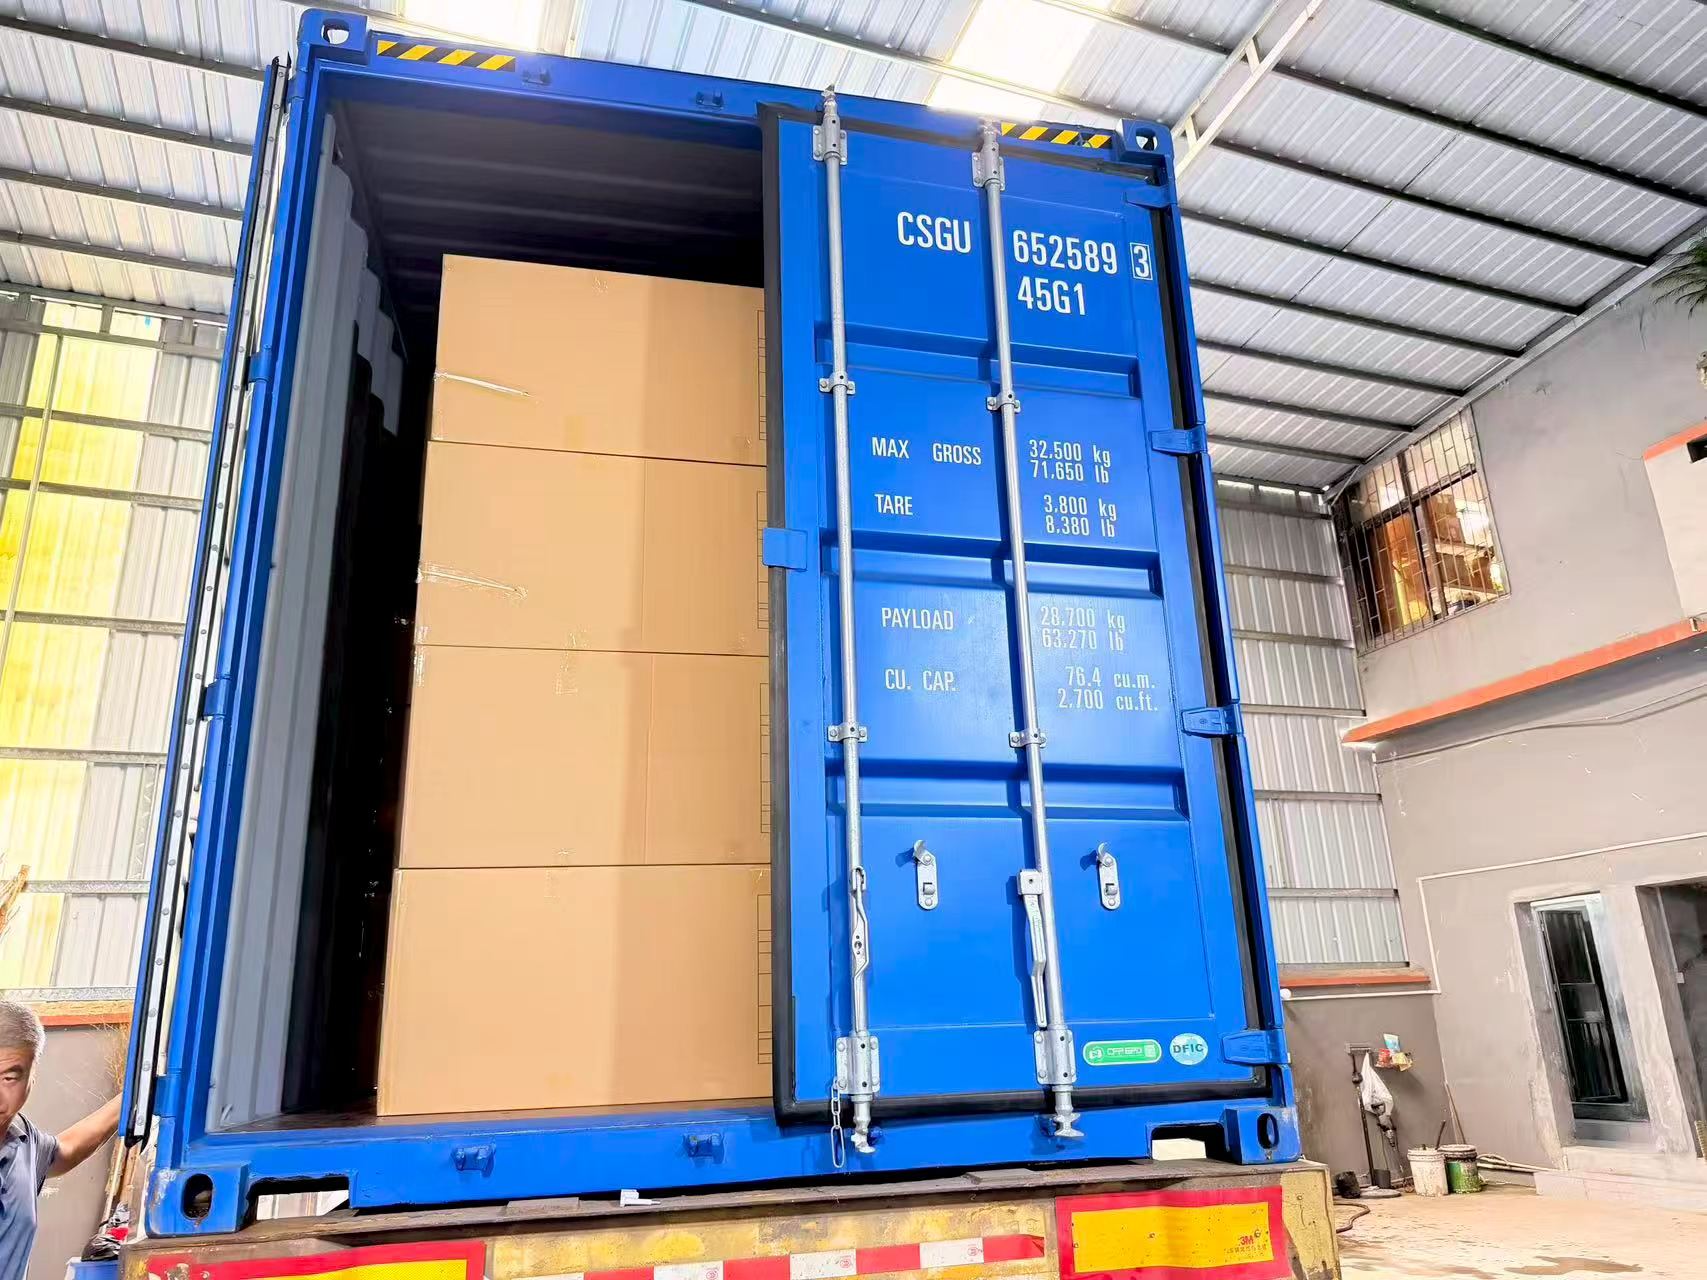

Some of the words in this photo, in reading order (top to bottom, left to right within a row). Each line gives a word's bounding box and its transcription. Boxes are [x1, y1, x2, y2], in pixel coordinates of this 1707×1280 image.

[898, 211, 972, 254] CSGU
[1013, 229, 1118, 275] 652589
[1133, 246, 1150, 279] 3
[1017, 276, 1086, 316] 45G1
[872, 436, 910, 459] MAX
[932, 442, 982, 466] GROSS
[1093, 445, 1111, 468] kg
[1095, 465, 1110, 484] lb
[874, 493, 913, 516] TARE
[1098, 498, 1117, 522] kg
[1101, 518, 1116, 538] lb
[881, 607, 954, 631] PAYLOAD
[1107, 609, 1126, 633] kg
[1109, 630, 1125, 651] lb
[885, 668, 912, 690] CU.
[922, 670, 957, 692] CAP.
[1065, 666, 1102, 687] 76.4
[1113, 672, 1156, 689] cu.m.
[1116, 690, 1159, 711] cu.ft.
[1172, 1043, 1204, 1054] DFIC
[1240, 1235, 1254, 1246] 3M
